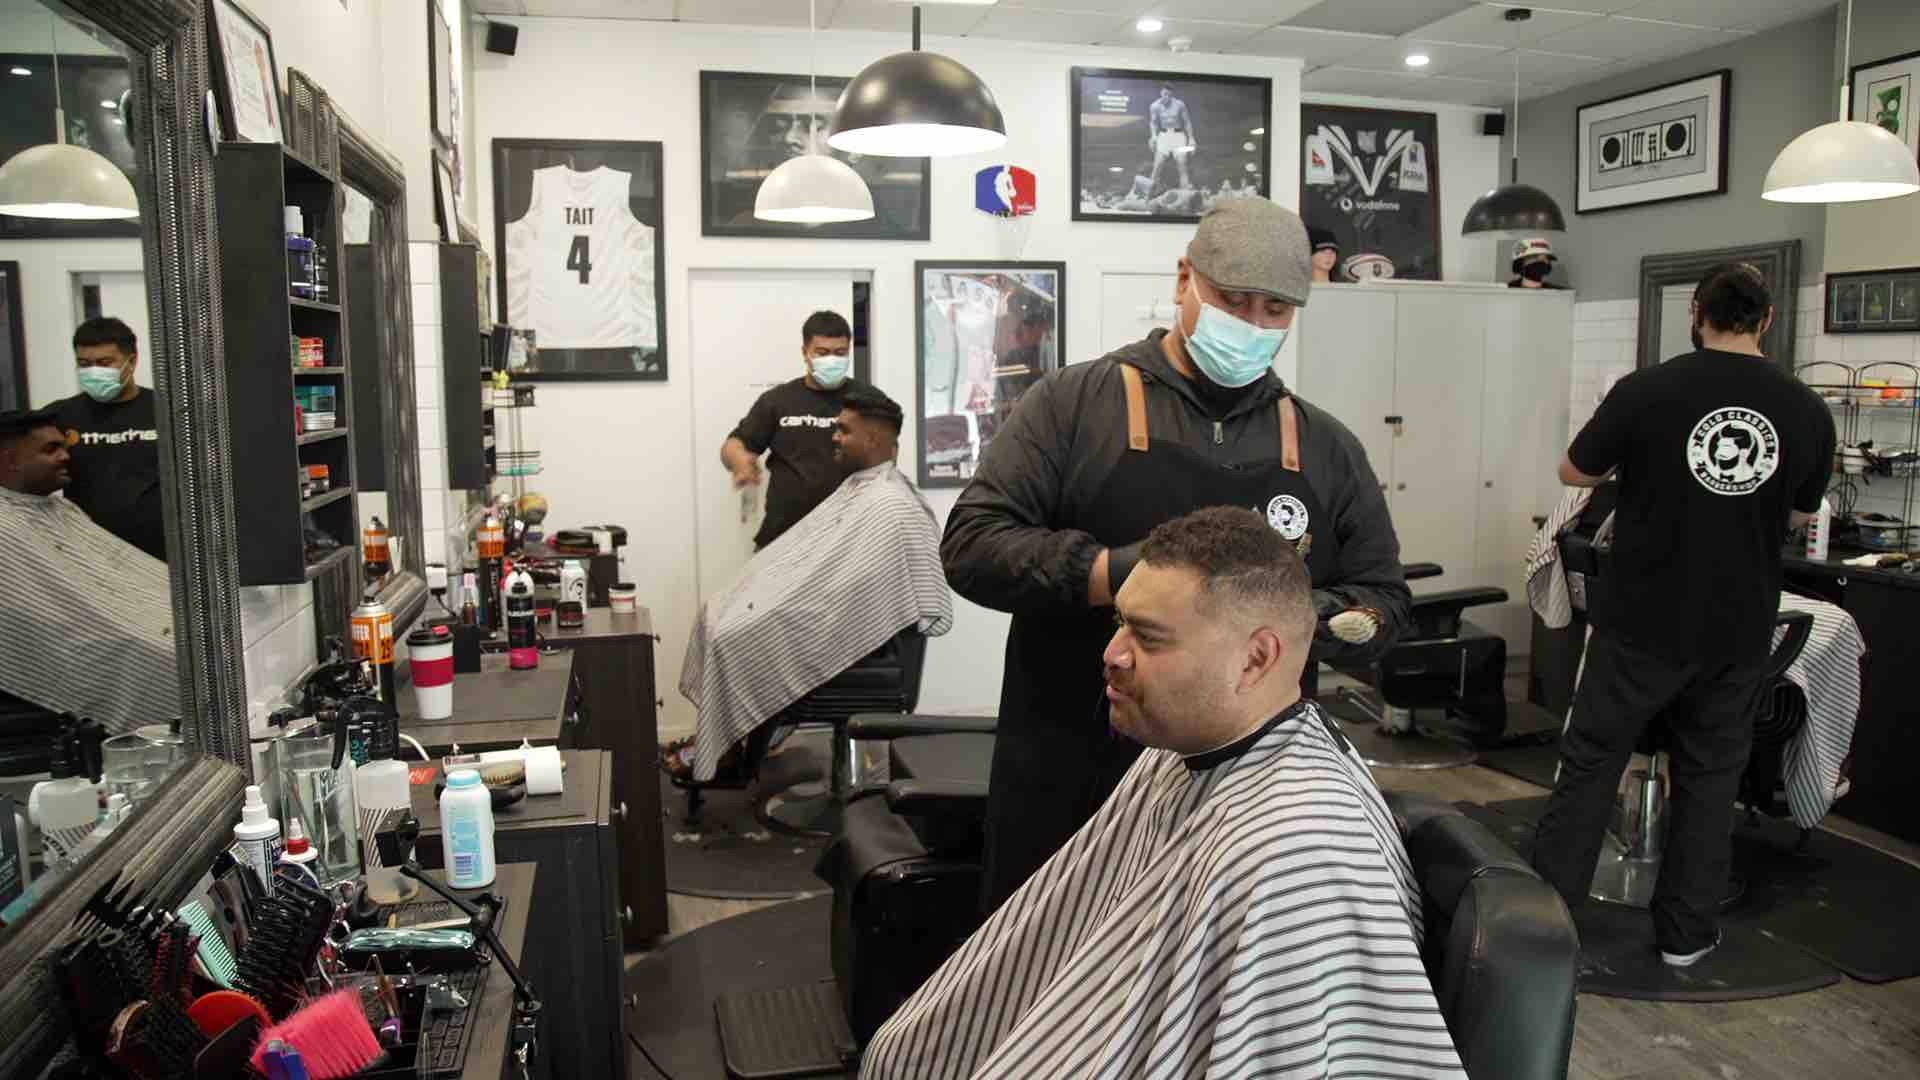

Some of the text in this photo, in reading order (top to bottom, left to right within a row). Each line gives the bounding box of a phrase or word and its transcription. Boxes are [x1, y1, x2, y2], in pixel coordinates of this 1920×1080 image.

[563, 207, 595, 225] TAIT
[566, 235, 593, 284] 4
[779, 413, 839, 428] carhar
